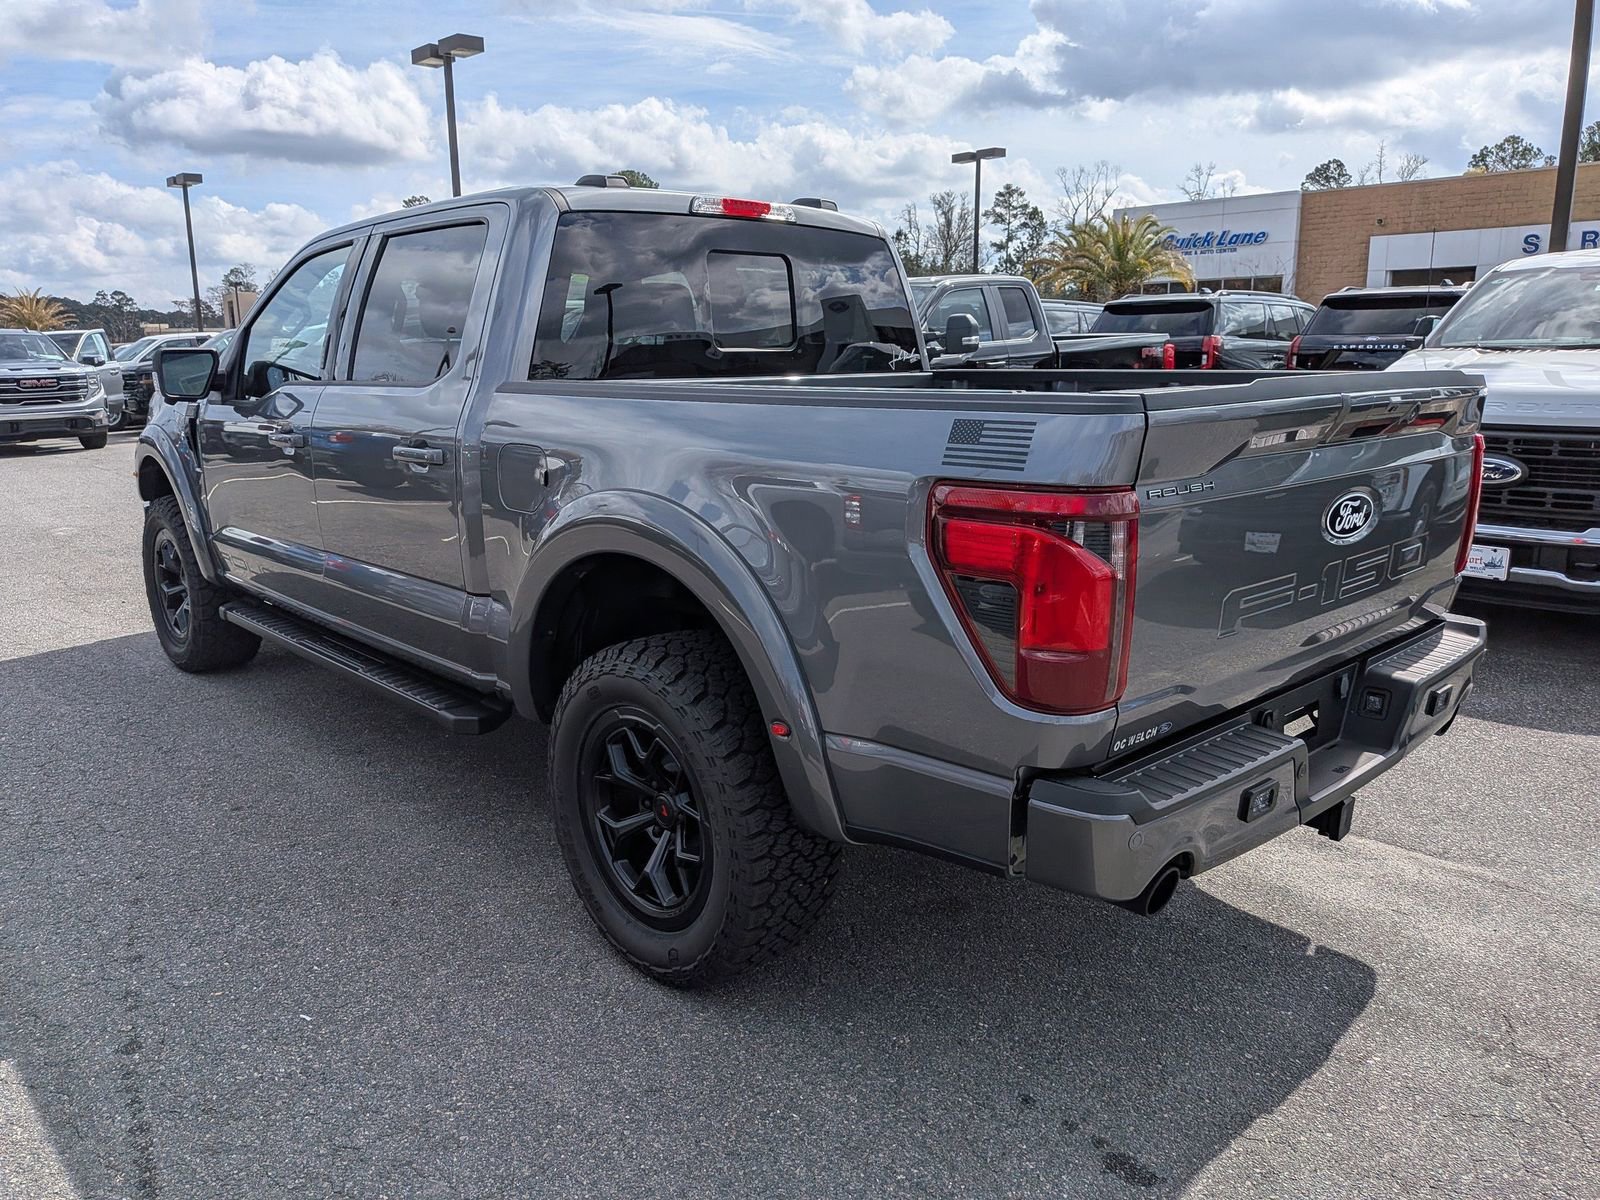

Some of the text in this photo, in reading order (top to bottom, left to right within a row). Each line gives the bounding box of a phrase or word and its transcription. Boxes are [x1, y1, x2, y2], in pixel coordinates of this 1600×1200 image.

[1163, 230, 1267, 250] Quick Lane
[20, 379, 58, 388] GMC
[1146, 481, 1216, 500] ROUSH
[1334, 499, 1367, 532] Ford
[1217, 532, 1430, 639] F-150
[1113, 739, 1127, 752] OC
[1128, 726, 1158, 747] WELCH
